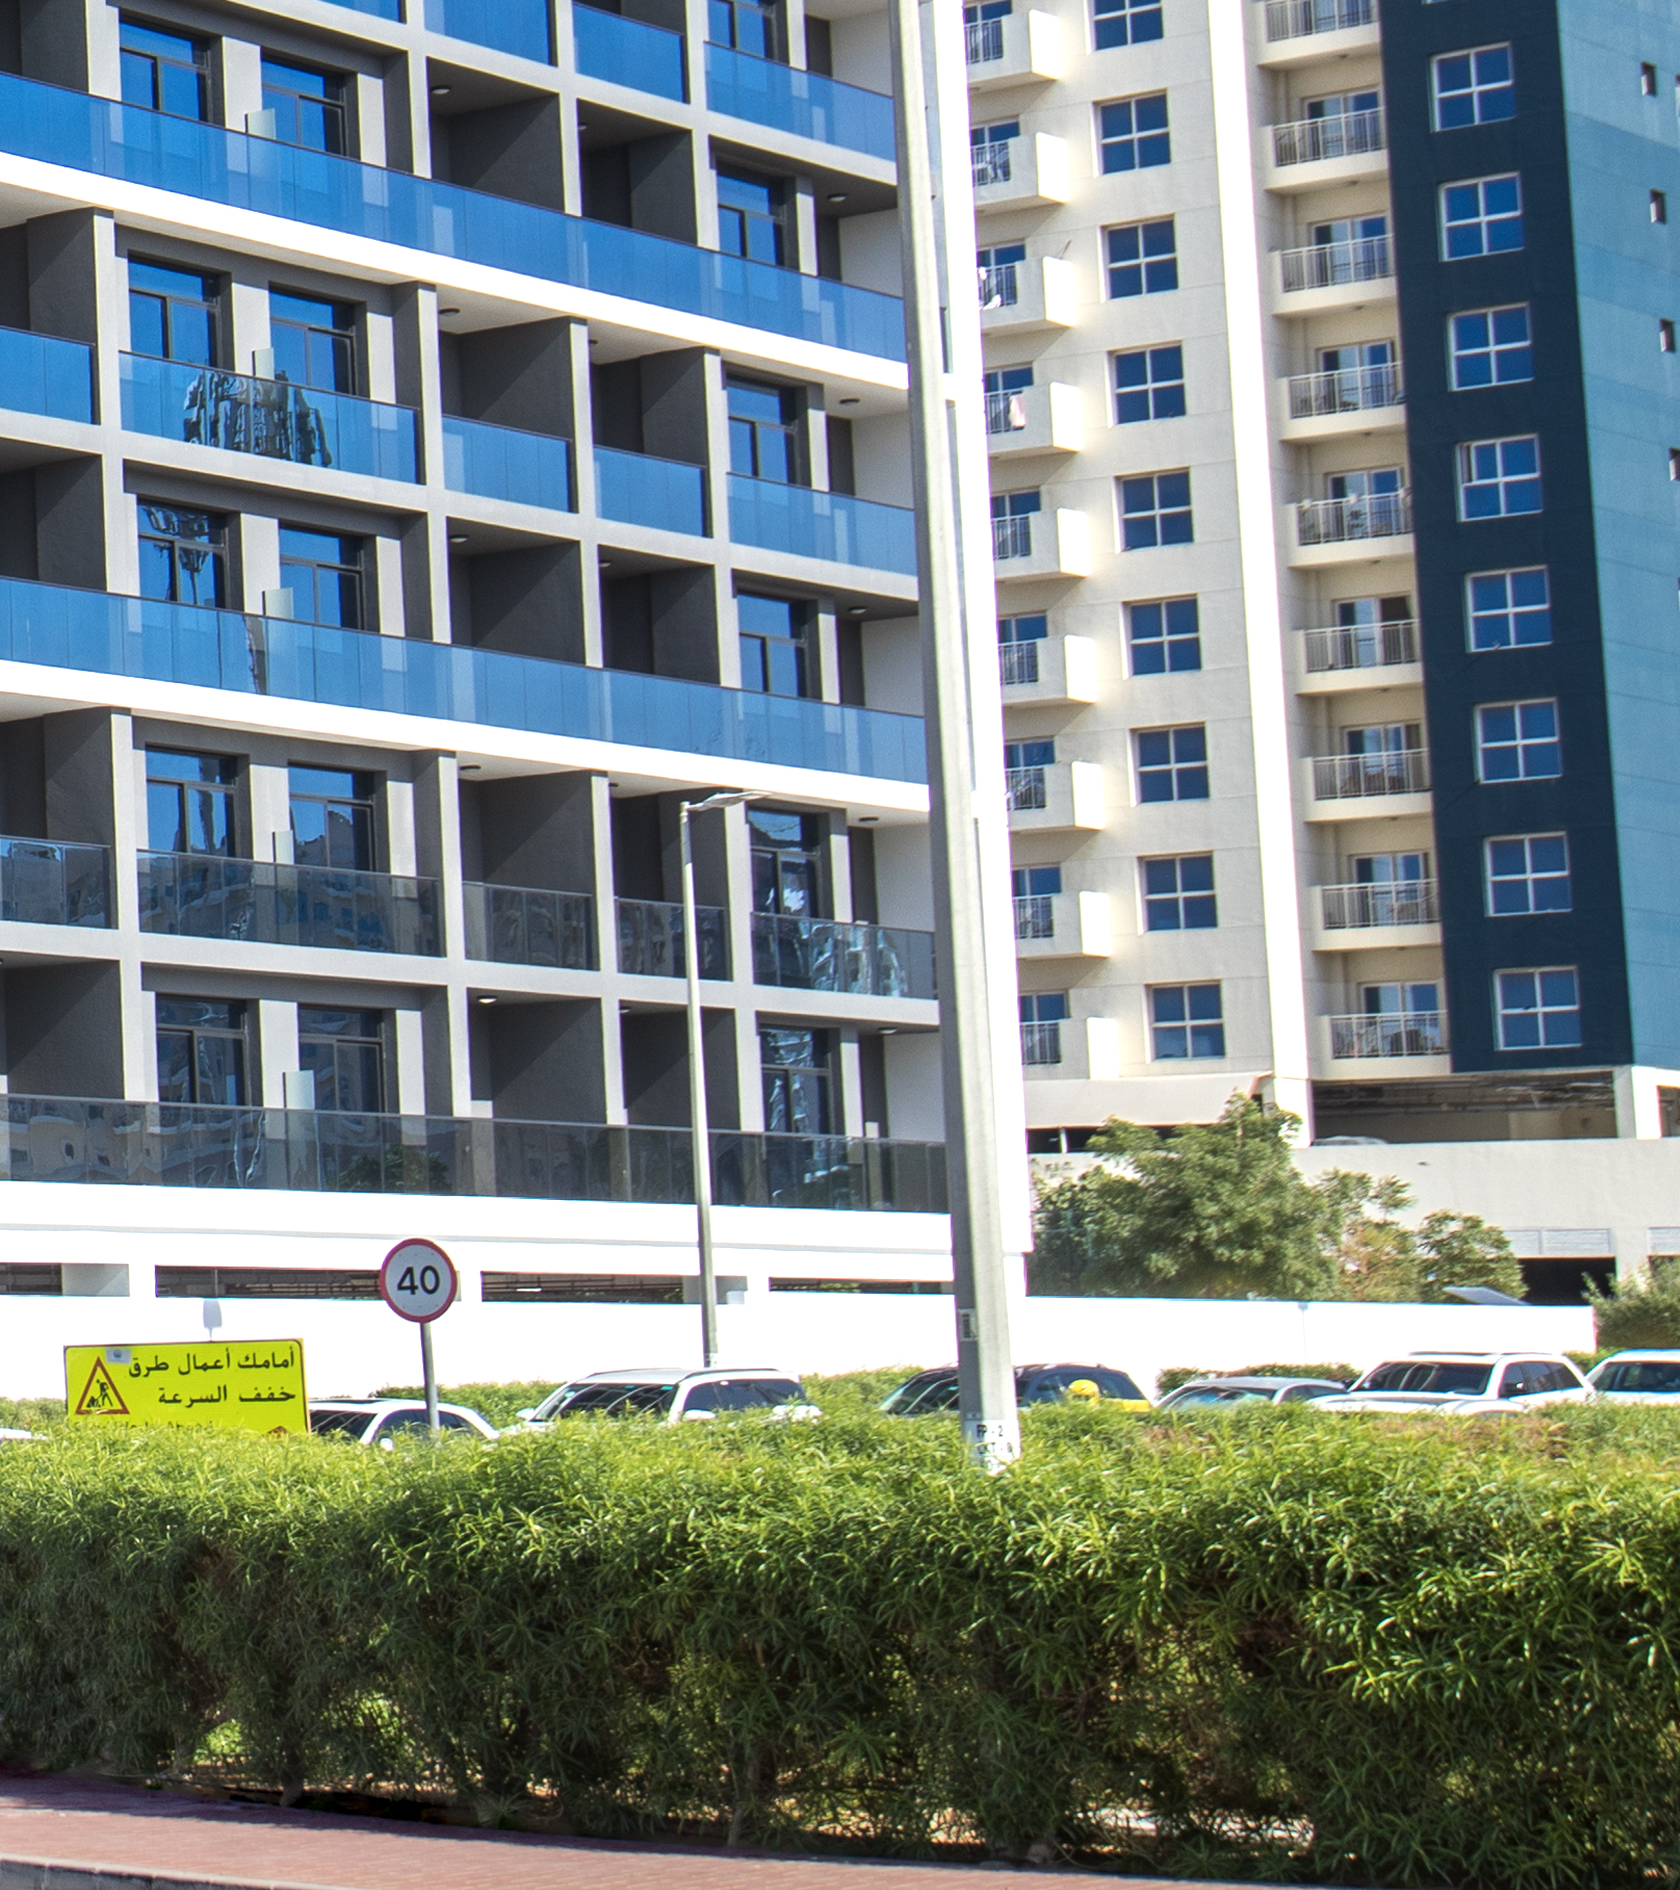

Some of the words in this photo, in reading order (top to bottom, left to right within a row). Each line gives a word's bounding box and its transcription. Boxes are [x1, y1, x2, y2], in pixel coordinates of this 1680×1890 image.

[397, 1265, 440, 1295] 40
[129, 1355, 169, 1377] طرق
[178, 1348, 230, 1375] أعمال
[238, 1346, 294, 1369] أمامك
[159, 1385, 227, 1408] السرعة
[239, 1385, 296, 1402] خفف
[998, 1424, 1004, 1437] 2
